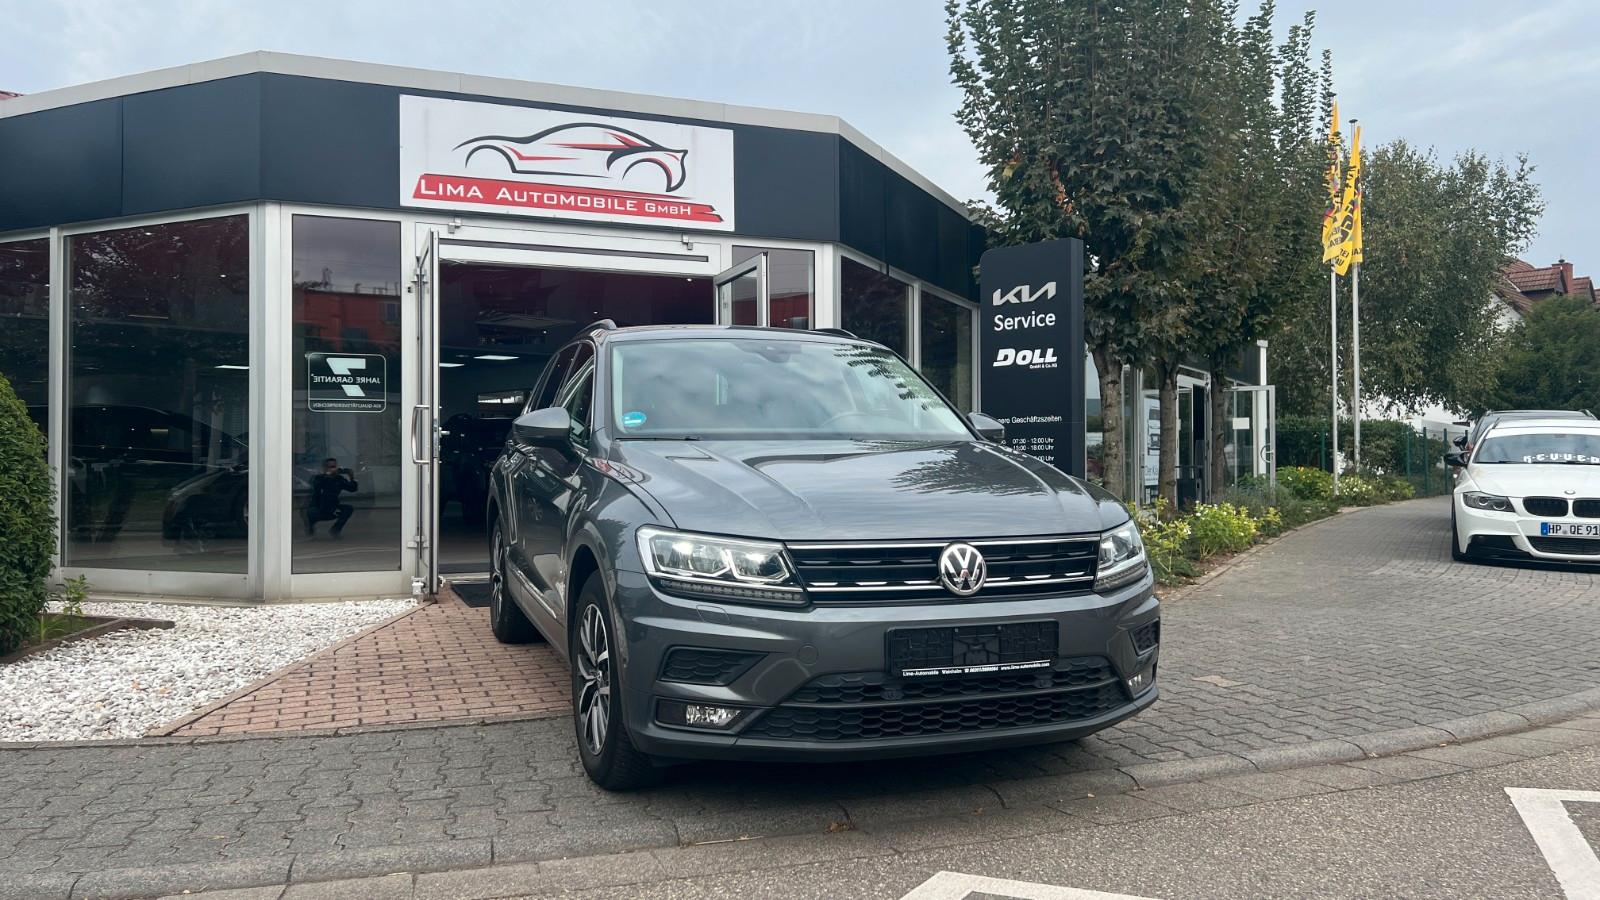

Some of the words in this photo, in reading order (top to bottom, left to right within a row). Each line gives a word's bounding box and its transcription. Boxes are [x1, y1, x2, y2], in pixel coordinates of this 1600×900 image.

[419, 178, 483, 199] LIMA
[496, 187, 637, 212] AUTOMOBILE
[993, 281, 1056, 306] KIA
[994, 311, 1056, 332] Service
[992, 347, 1058, 367] DOLL
[1548, 524, 1562, 534] HP
[1570, 525, 1583, 535] QE
[1586, 526, 1599, 535] 91
